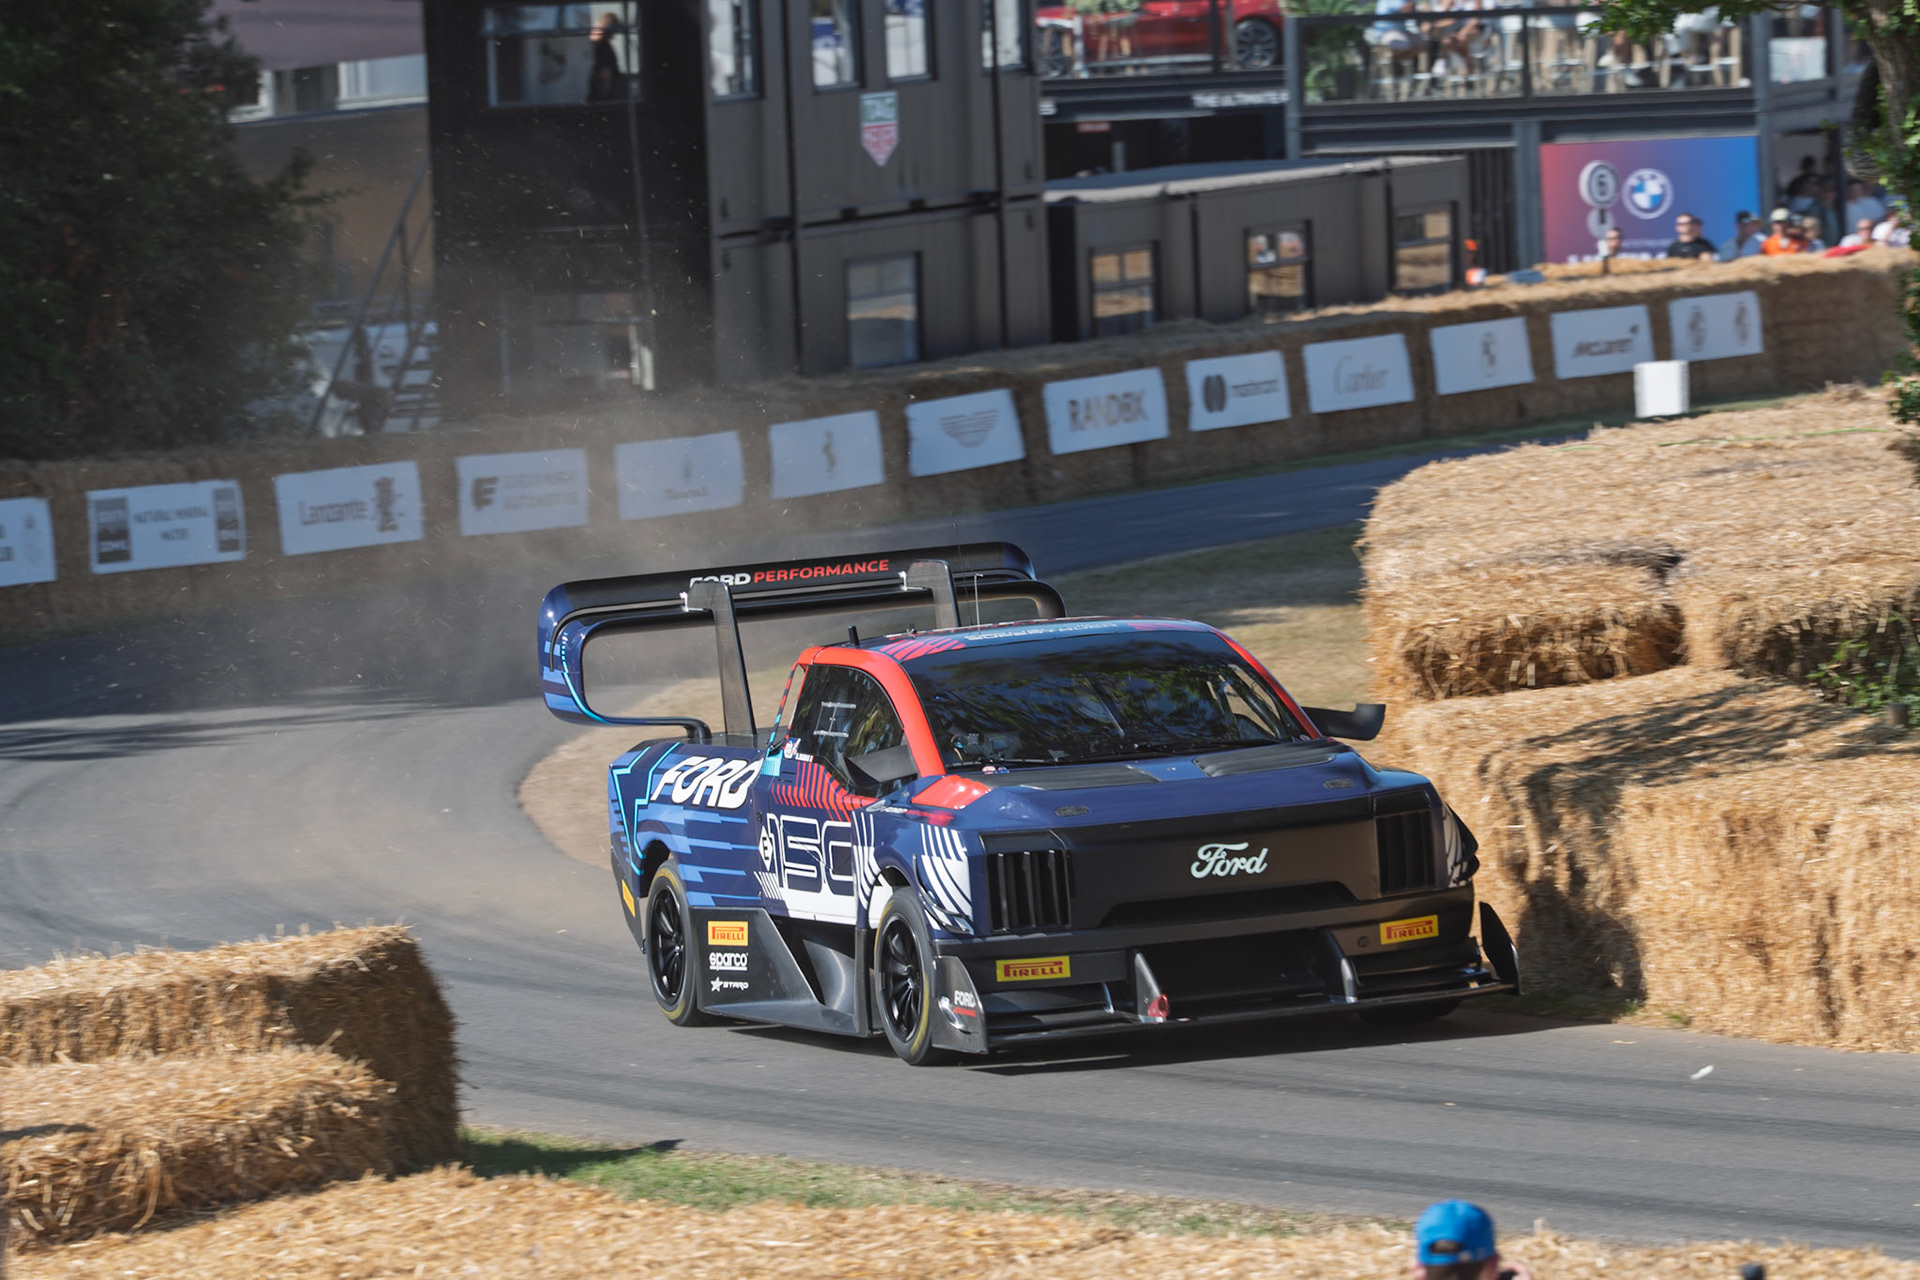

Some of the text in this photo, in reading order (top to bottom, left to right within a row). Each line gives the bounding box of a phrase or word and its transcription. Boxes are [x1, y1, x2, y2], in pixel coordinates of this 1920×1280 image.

[753, 559, 889, 584] PERFORMANCE
[650, 755, 764, 809] FORD
[1190, 842, 1268, 879] Ford
[712, 926, 744, 940] PIRELLI
[1384, 917, 1434, 942] PIRELLI
[709, 951, 748, 971] sparco
[1003, 961, 1064, 979] PIRELLI
[954, 990, 976, 1008] FORD
